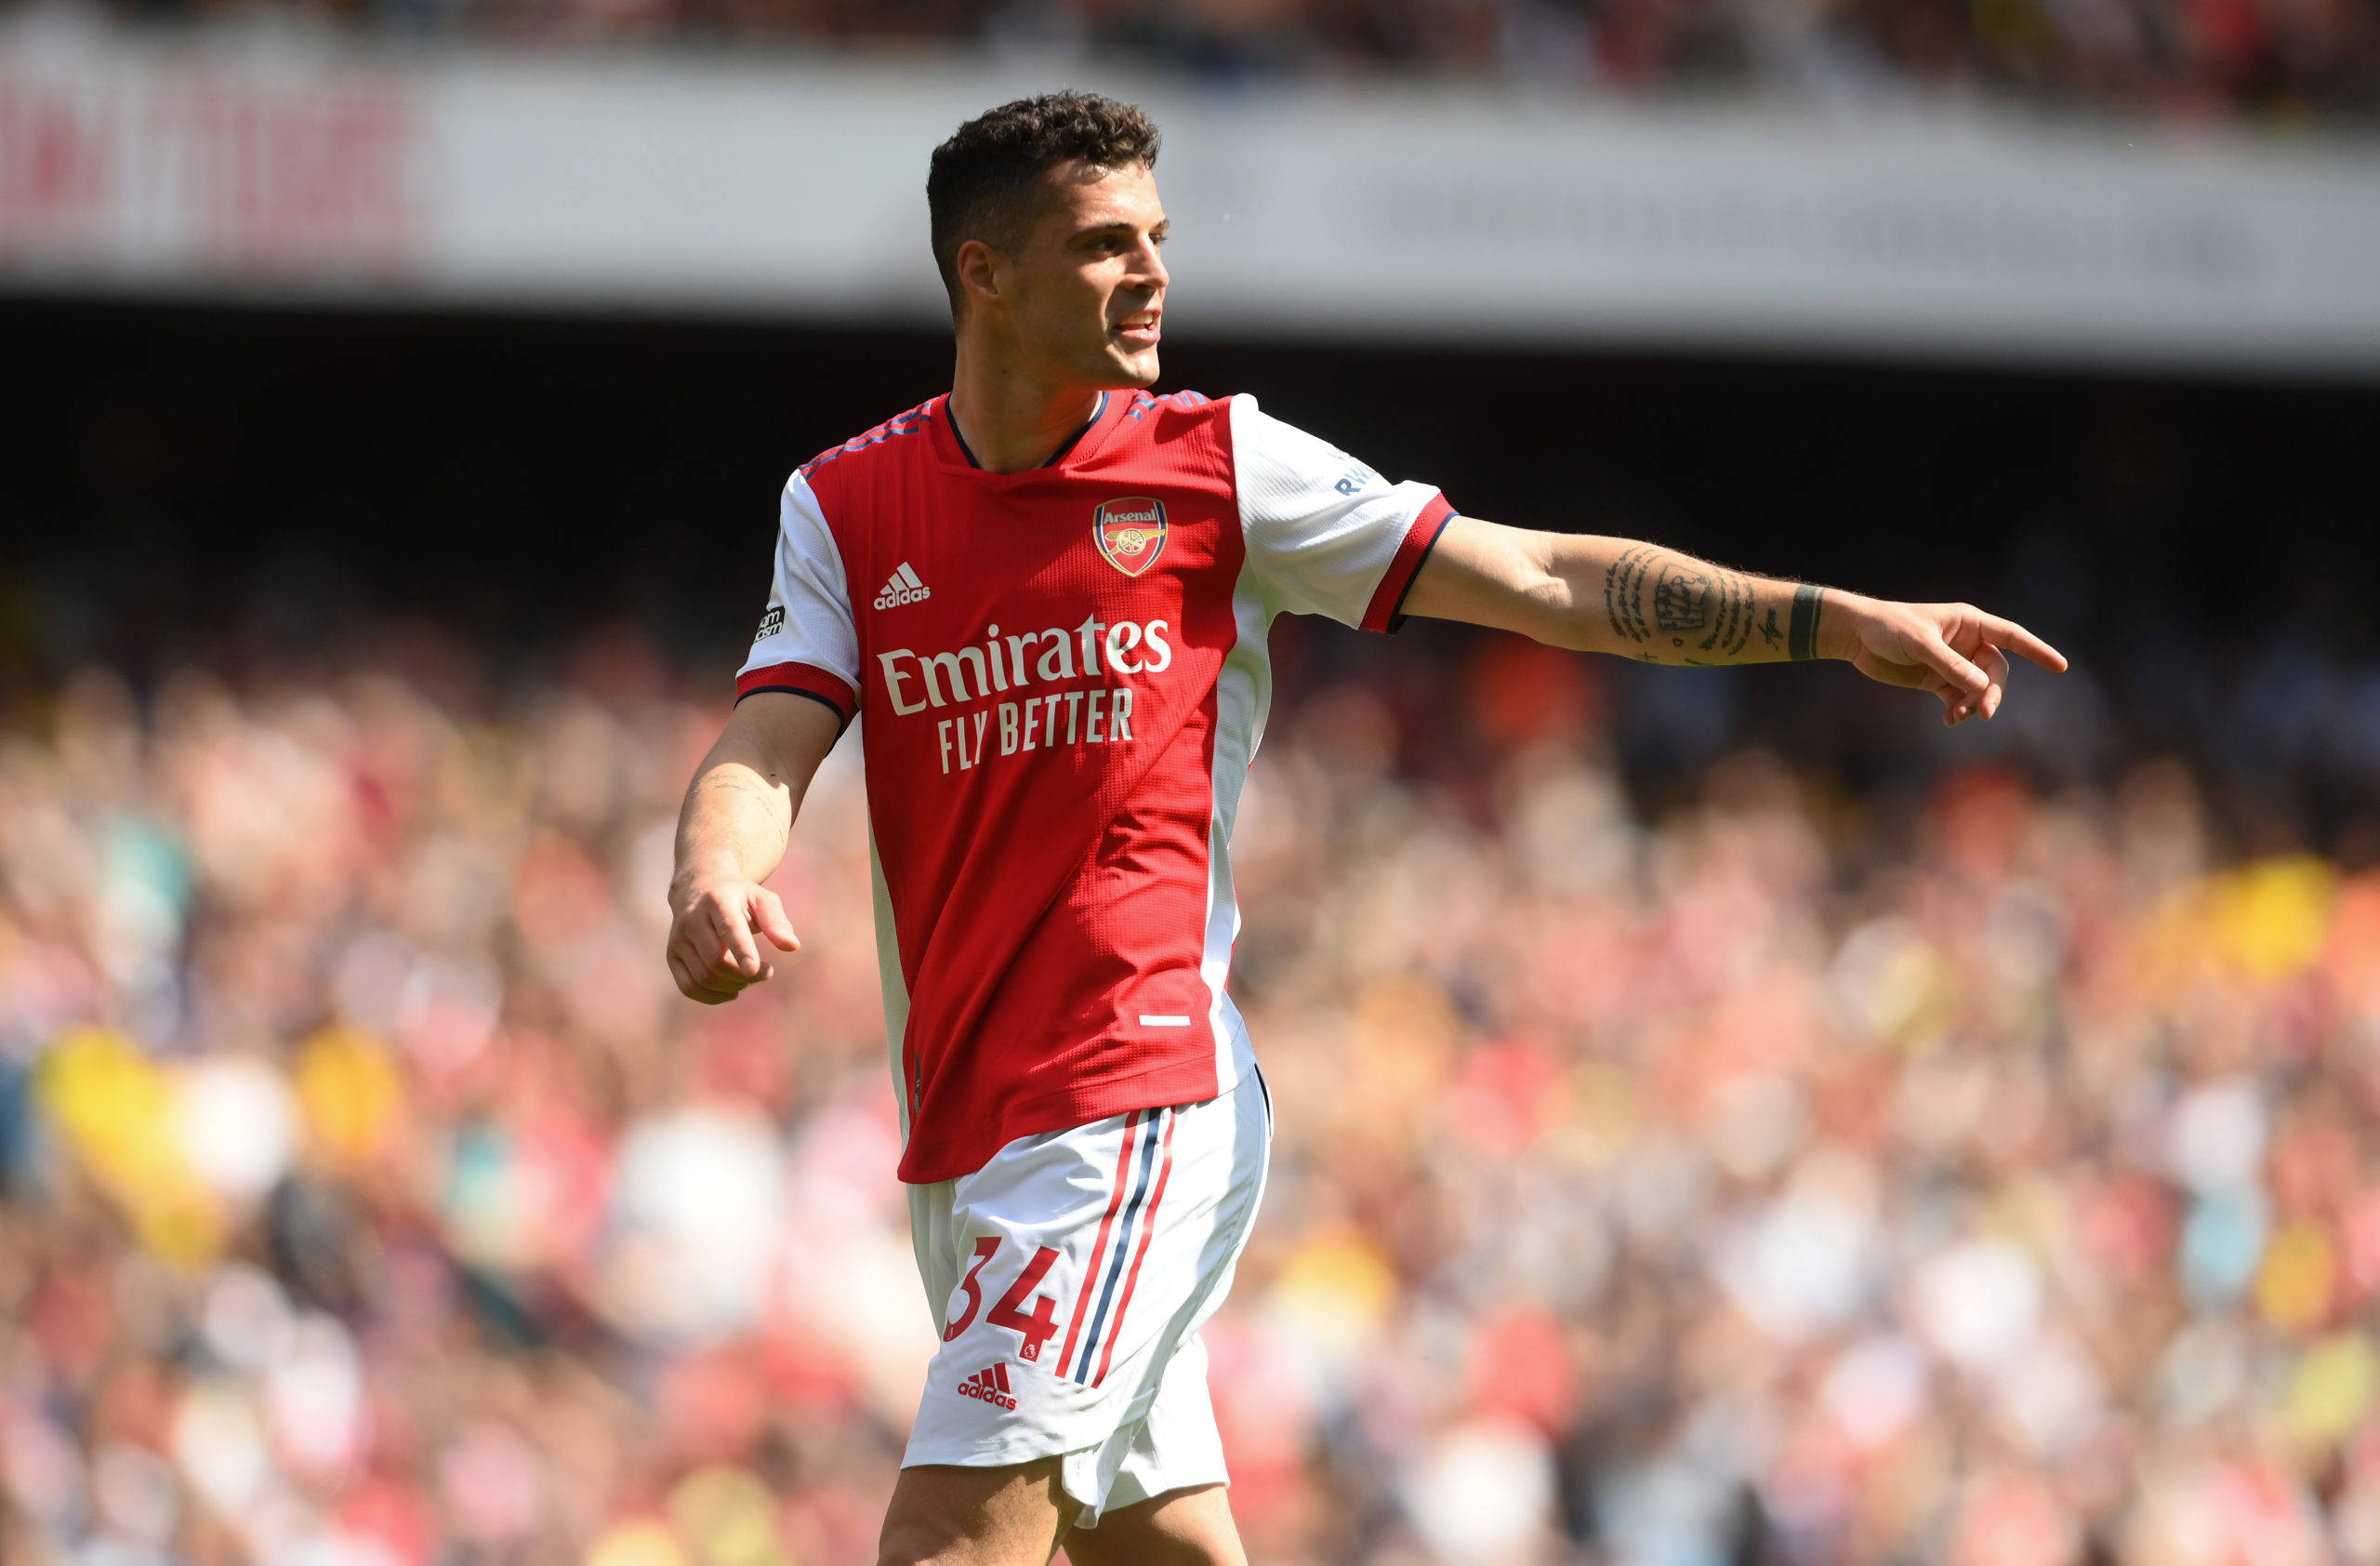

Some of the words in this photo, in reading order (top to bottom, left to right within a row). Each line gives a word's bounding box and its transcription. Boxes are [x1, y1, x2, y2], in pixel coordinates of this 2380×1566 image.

[1104, 509, 1156, 524] Arsenal
[873, 586, 931, 610] adidas
[877, 612, 1171, 716] Emirates
[937, 710, 987, 774] FLY
[998, 687, 1133, 757] BETTER
[943, 1236, 1061, 1362] 34
[958, 1382, 1018, 1411] adidas
